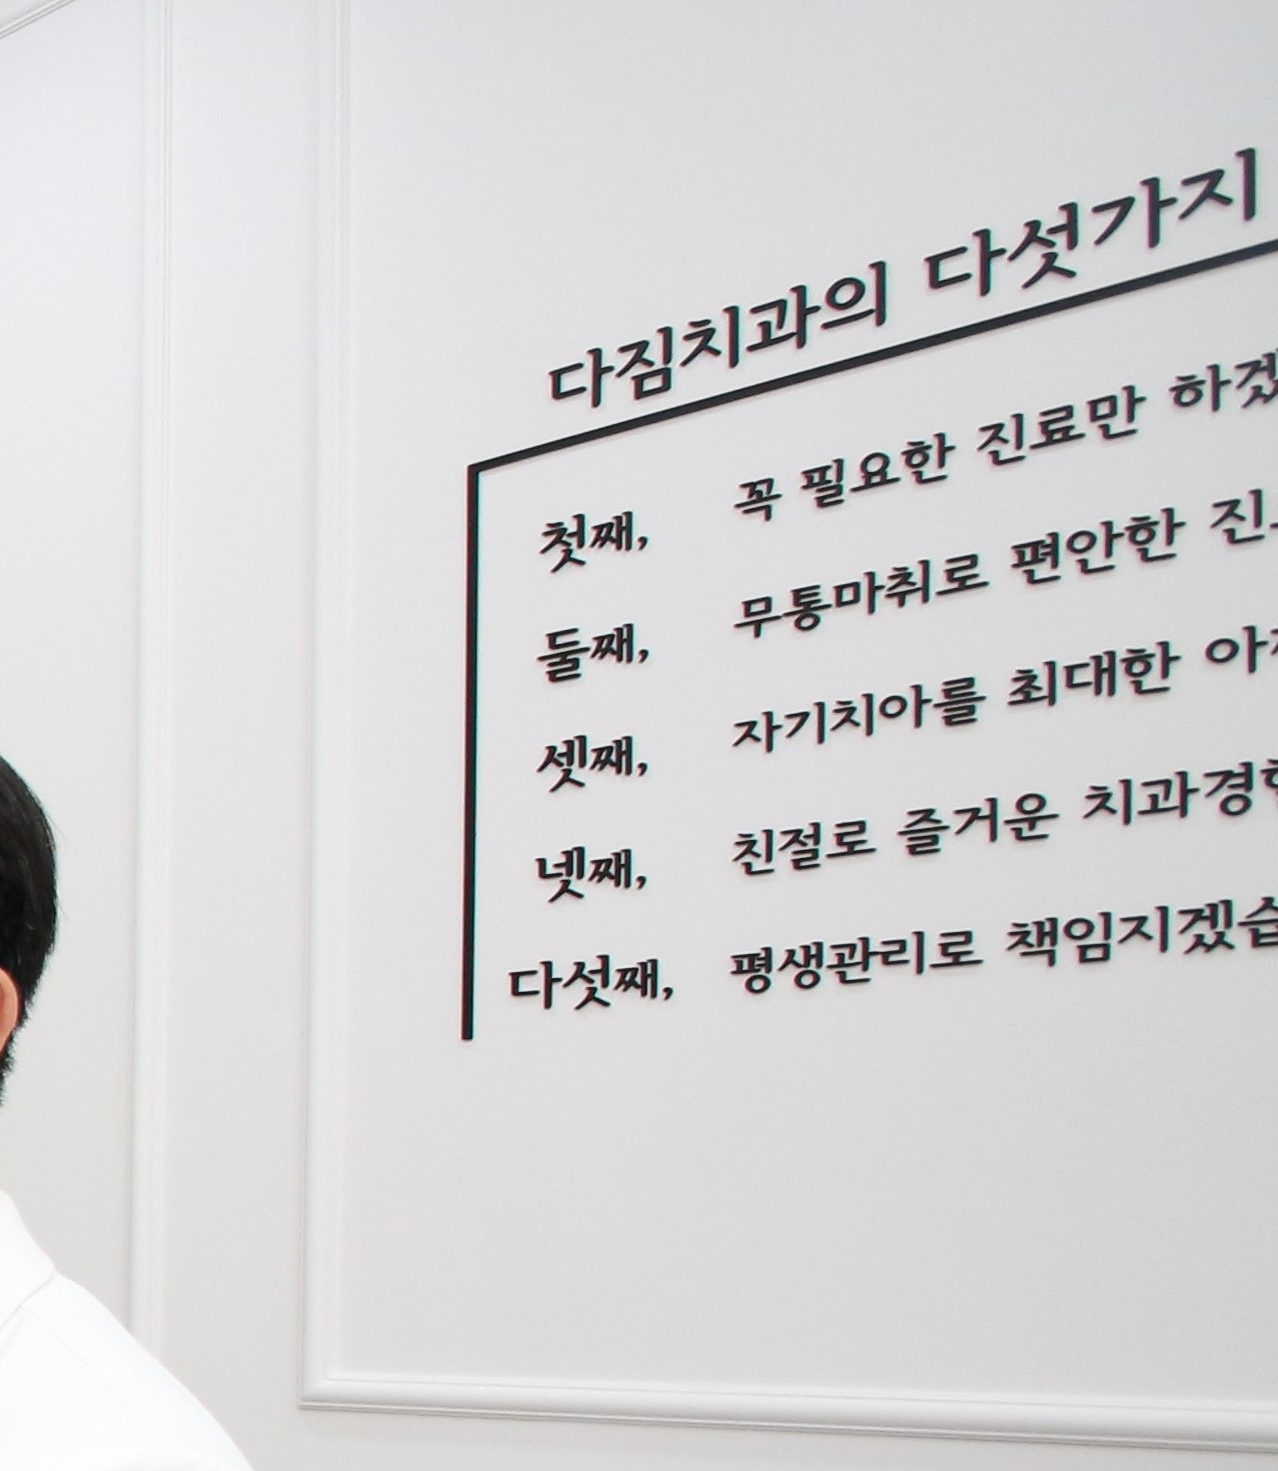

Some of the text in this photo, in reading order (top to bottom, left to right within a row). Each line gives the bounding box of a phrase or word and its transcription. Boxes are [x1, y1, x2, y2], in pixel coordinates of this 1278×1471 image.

[549, 148, 1256, 408] 다짐치과의 다섯가지
[541, 511, 648, 574] 첫째,
[734, 478, 782, 522] 꼭
[801, 433, 956, 509] 필요한
[977, 386, 1147, 466] 진료만
[537, 488, 1278, 683] 둘째, 무통마취로 편안한 진
[537, 625, 1278, 793] 셋째, 자기치아를 최대한 아
[535, 847, 647, 903] 넷째,
[732, 821, 877, 876] 친절로
[898, 794, 1060, 857] 즐거운
[509, 955, 674, 1011] 다섯째,
[730, 931, 984, 995] 평생관리로
